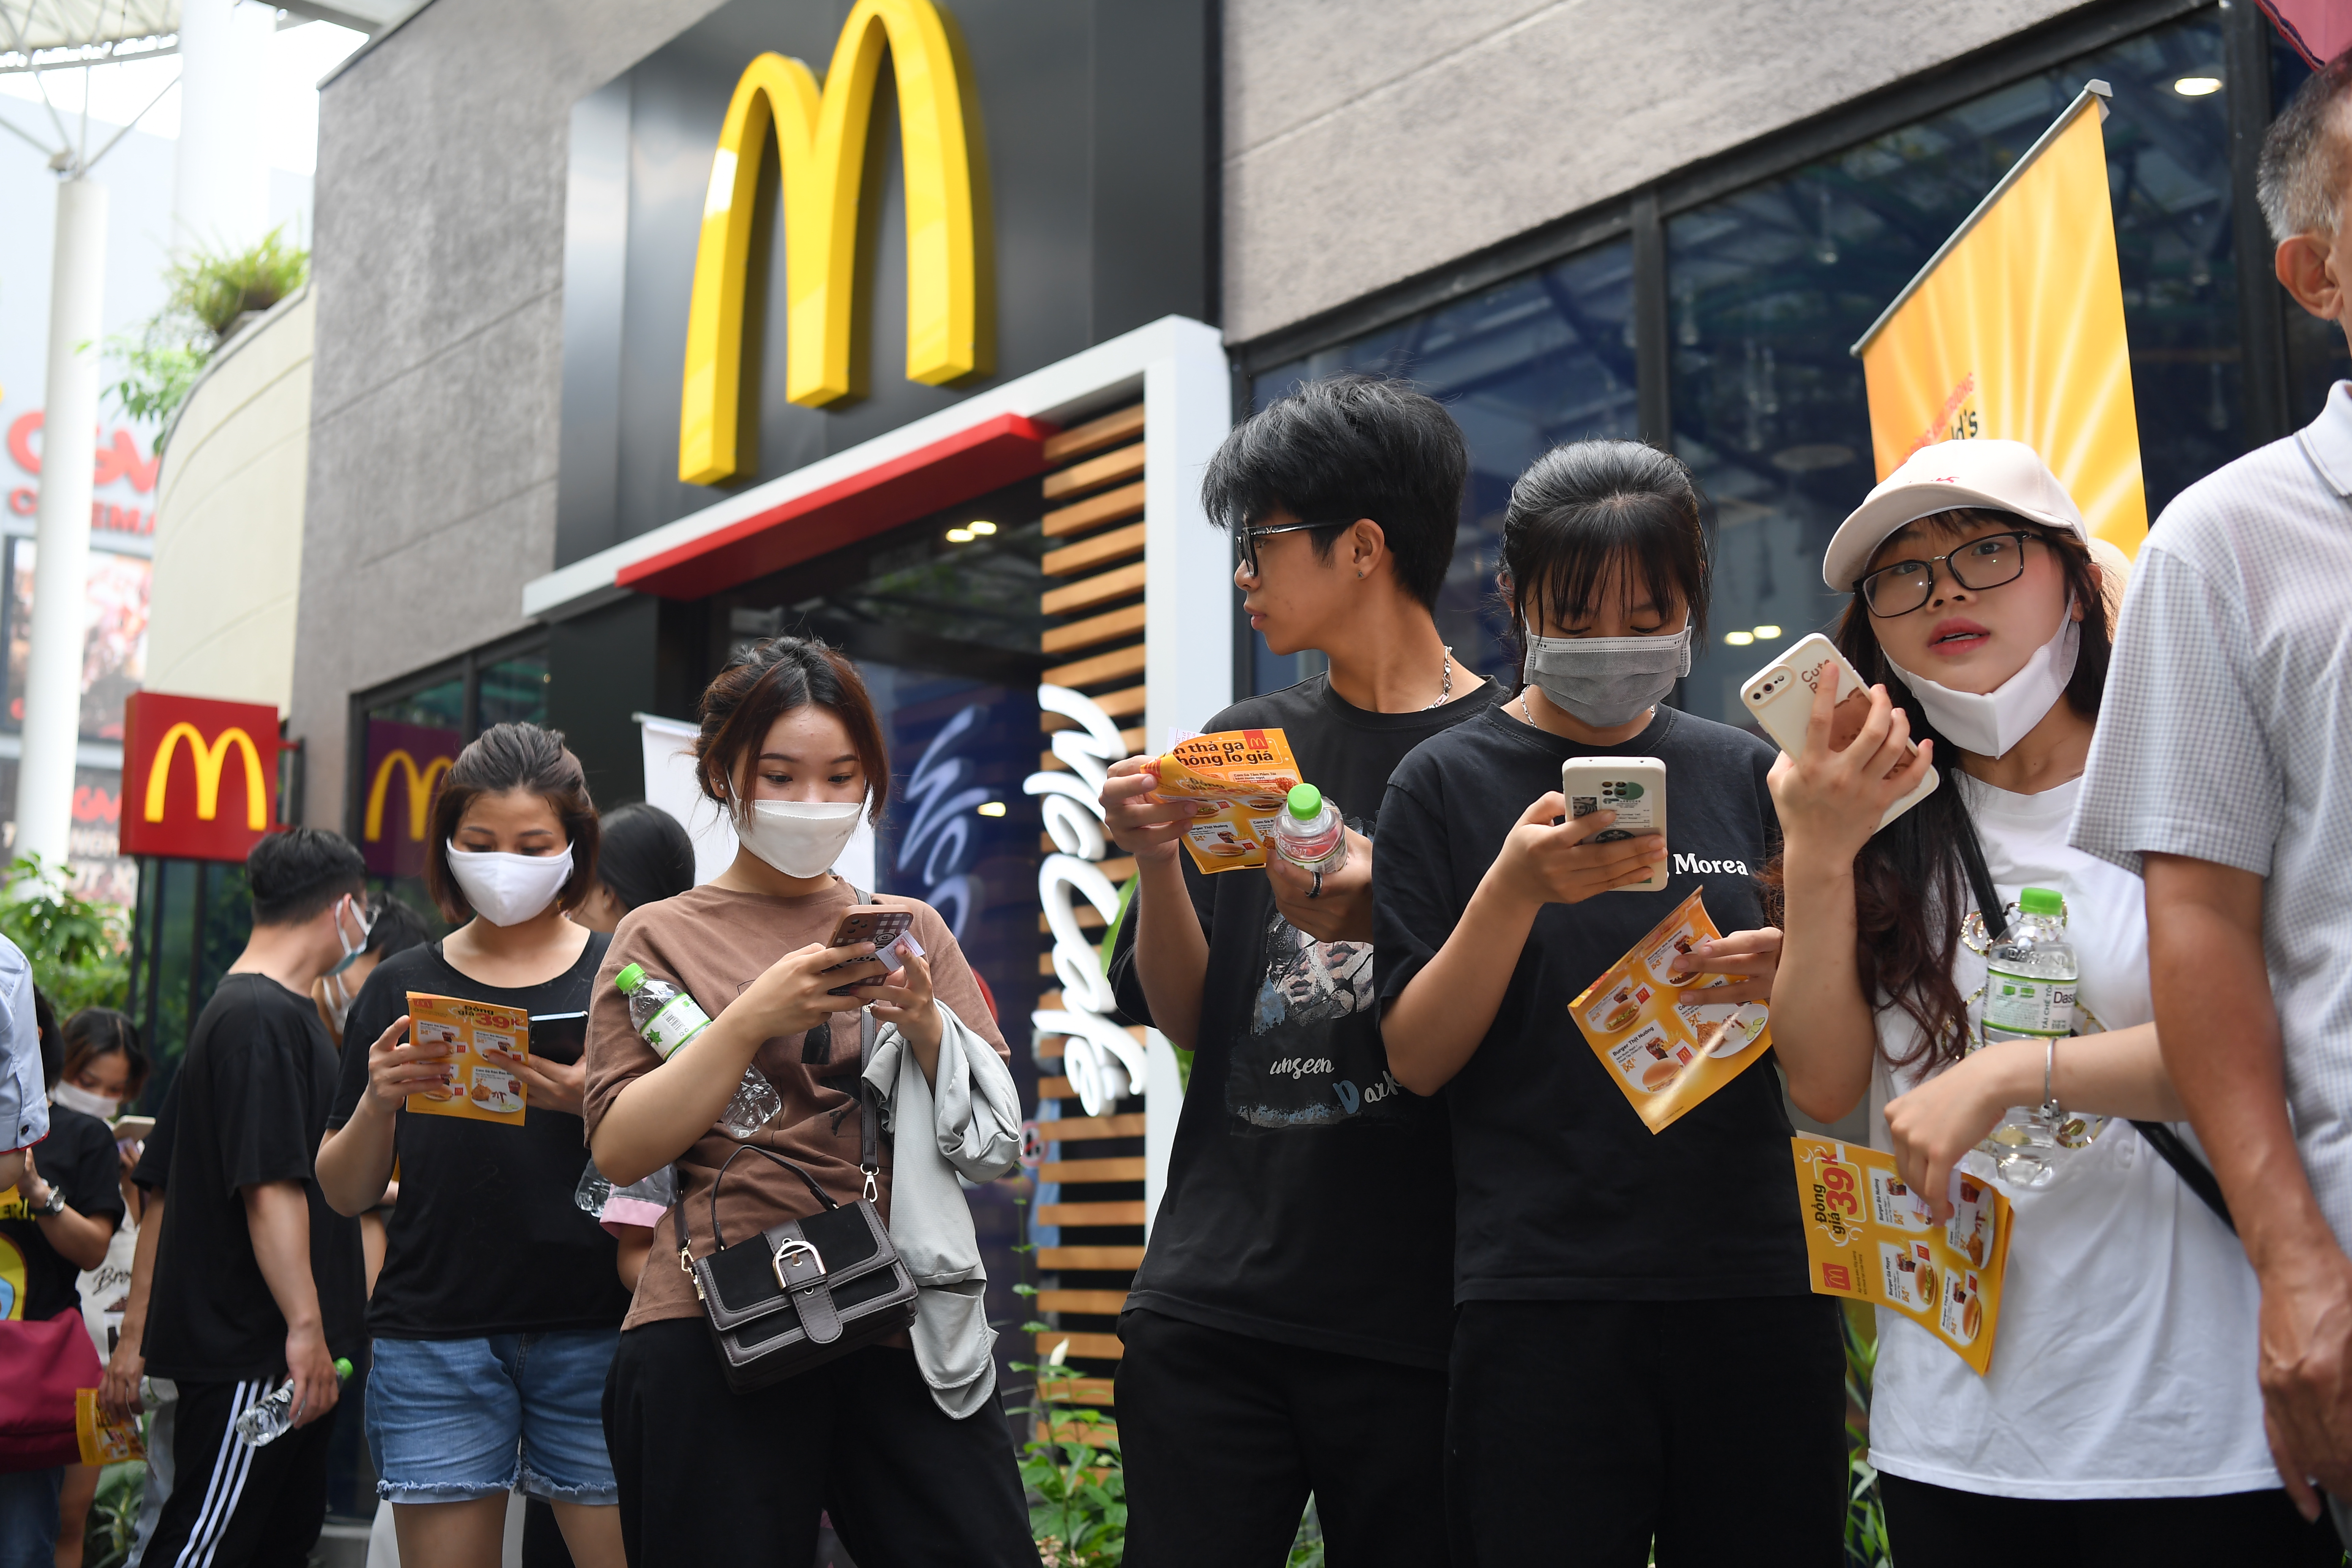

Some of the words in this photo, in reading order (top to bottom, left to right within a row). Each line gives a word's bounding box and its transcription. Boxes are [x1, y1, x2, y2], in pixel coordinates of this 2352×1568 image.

[1188, 740, 1218, 753] thả
[1222, 742, 1245, 753] ga
[1176, 754, 1224, 766] hông
[1225, 751, 1243, 763] lo
[1246, 749, 1274, 765] giá
[1673, 853, 1749, 876] Morea
[1612, 1043, 1630, 1057] Burger
[1828, 1212, 1846, 1235] giá
